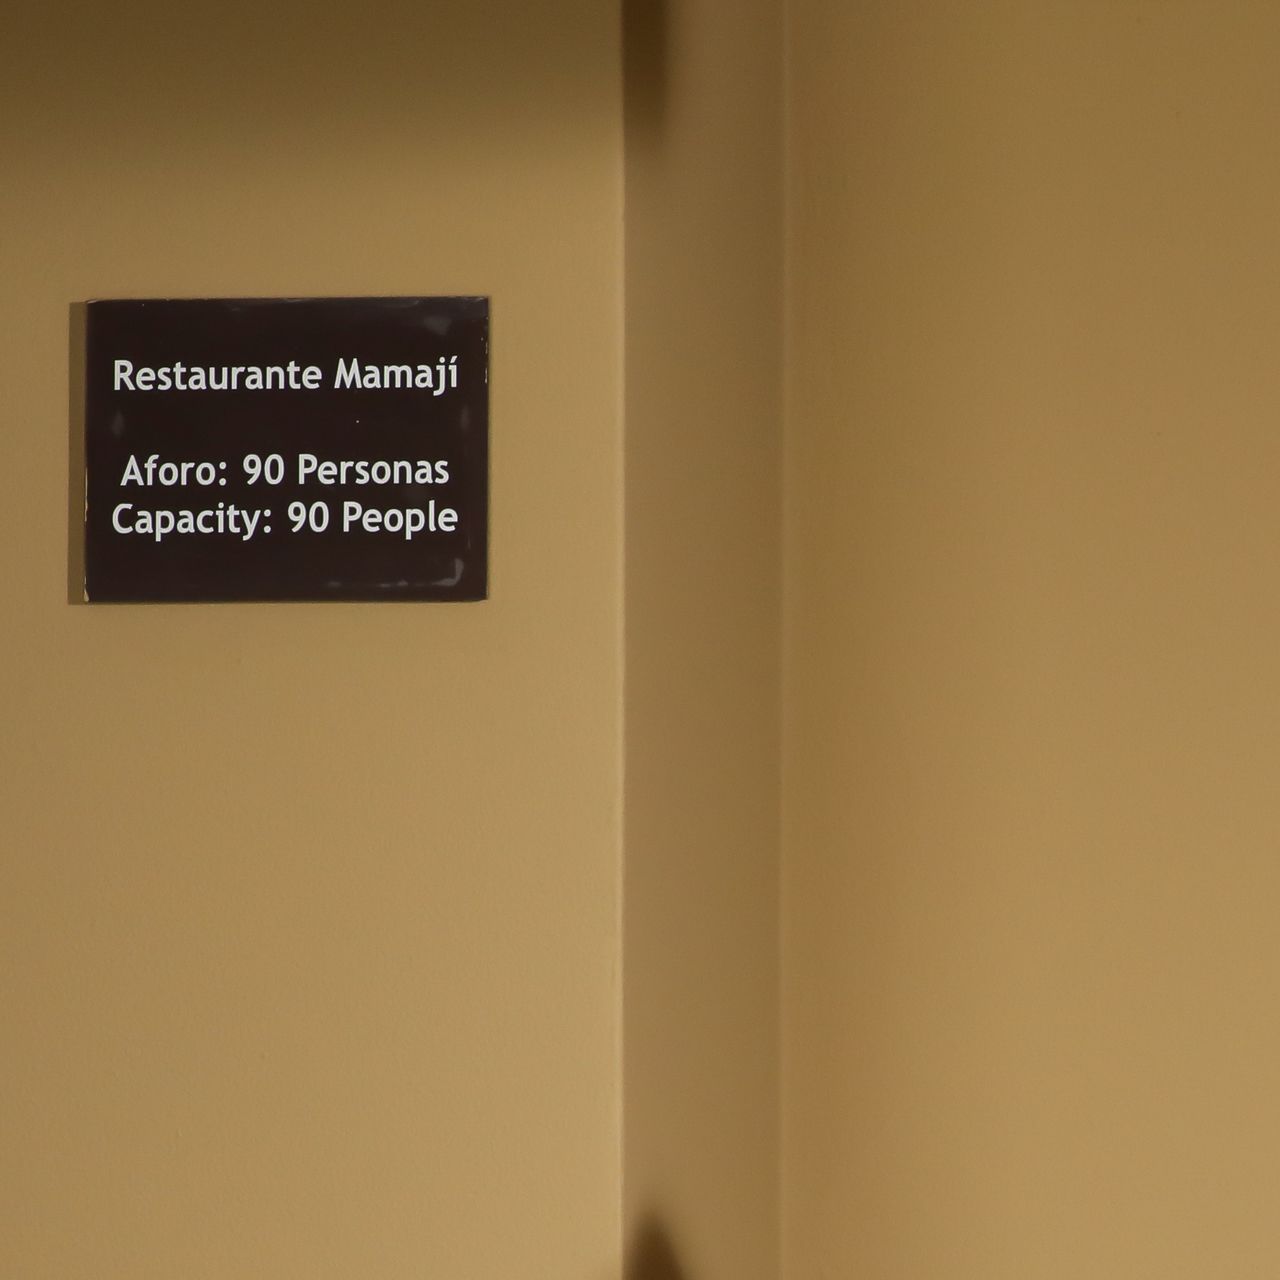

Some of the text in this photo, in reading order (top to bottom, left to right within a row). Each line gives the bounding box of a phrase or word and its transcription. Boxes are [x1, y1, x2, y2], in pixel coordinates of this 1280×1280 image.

[113, 356, 459, 396] Restaurante Mamají
[120, 453, 450, 486] Aforo: 90 Personas
[112, 500, 459, 541] Capacity: 90 People
